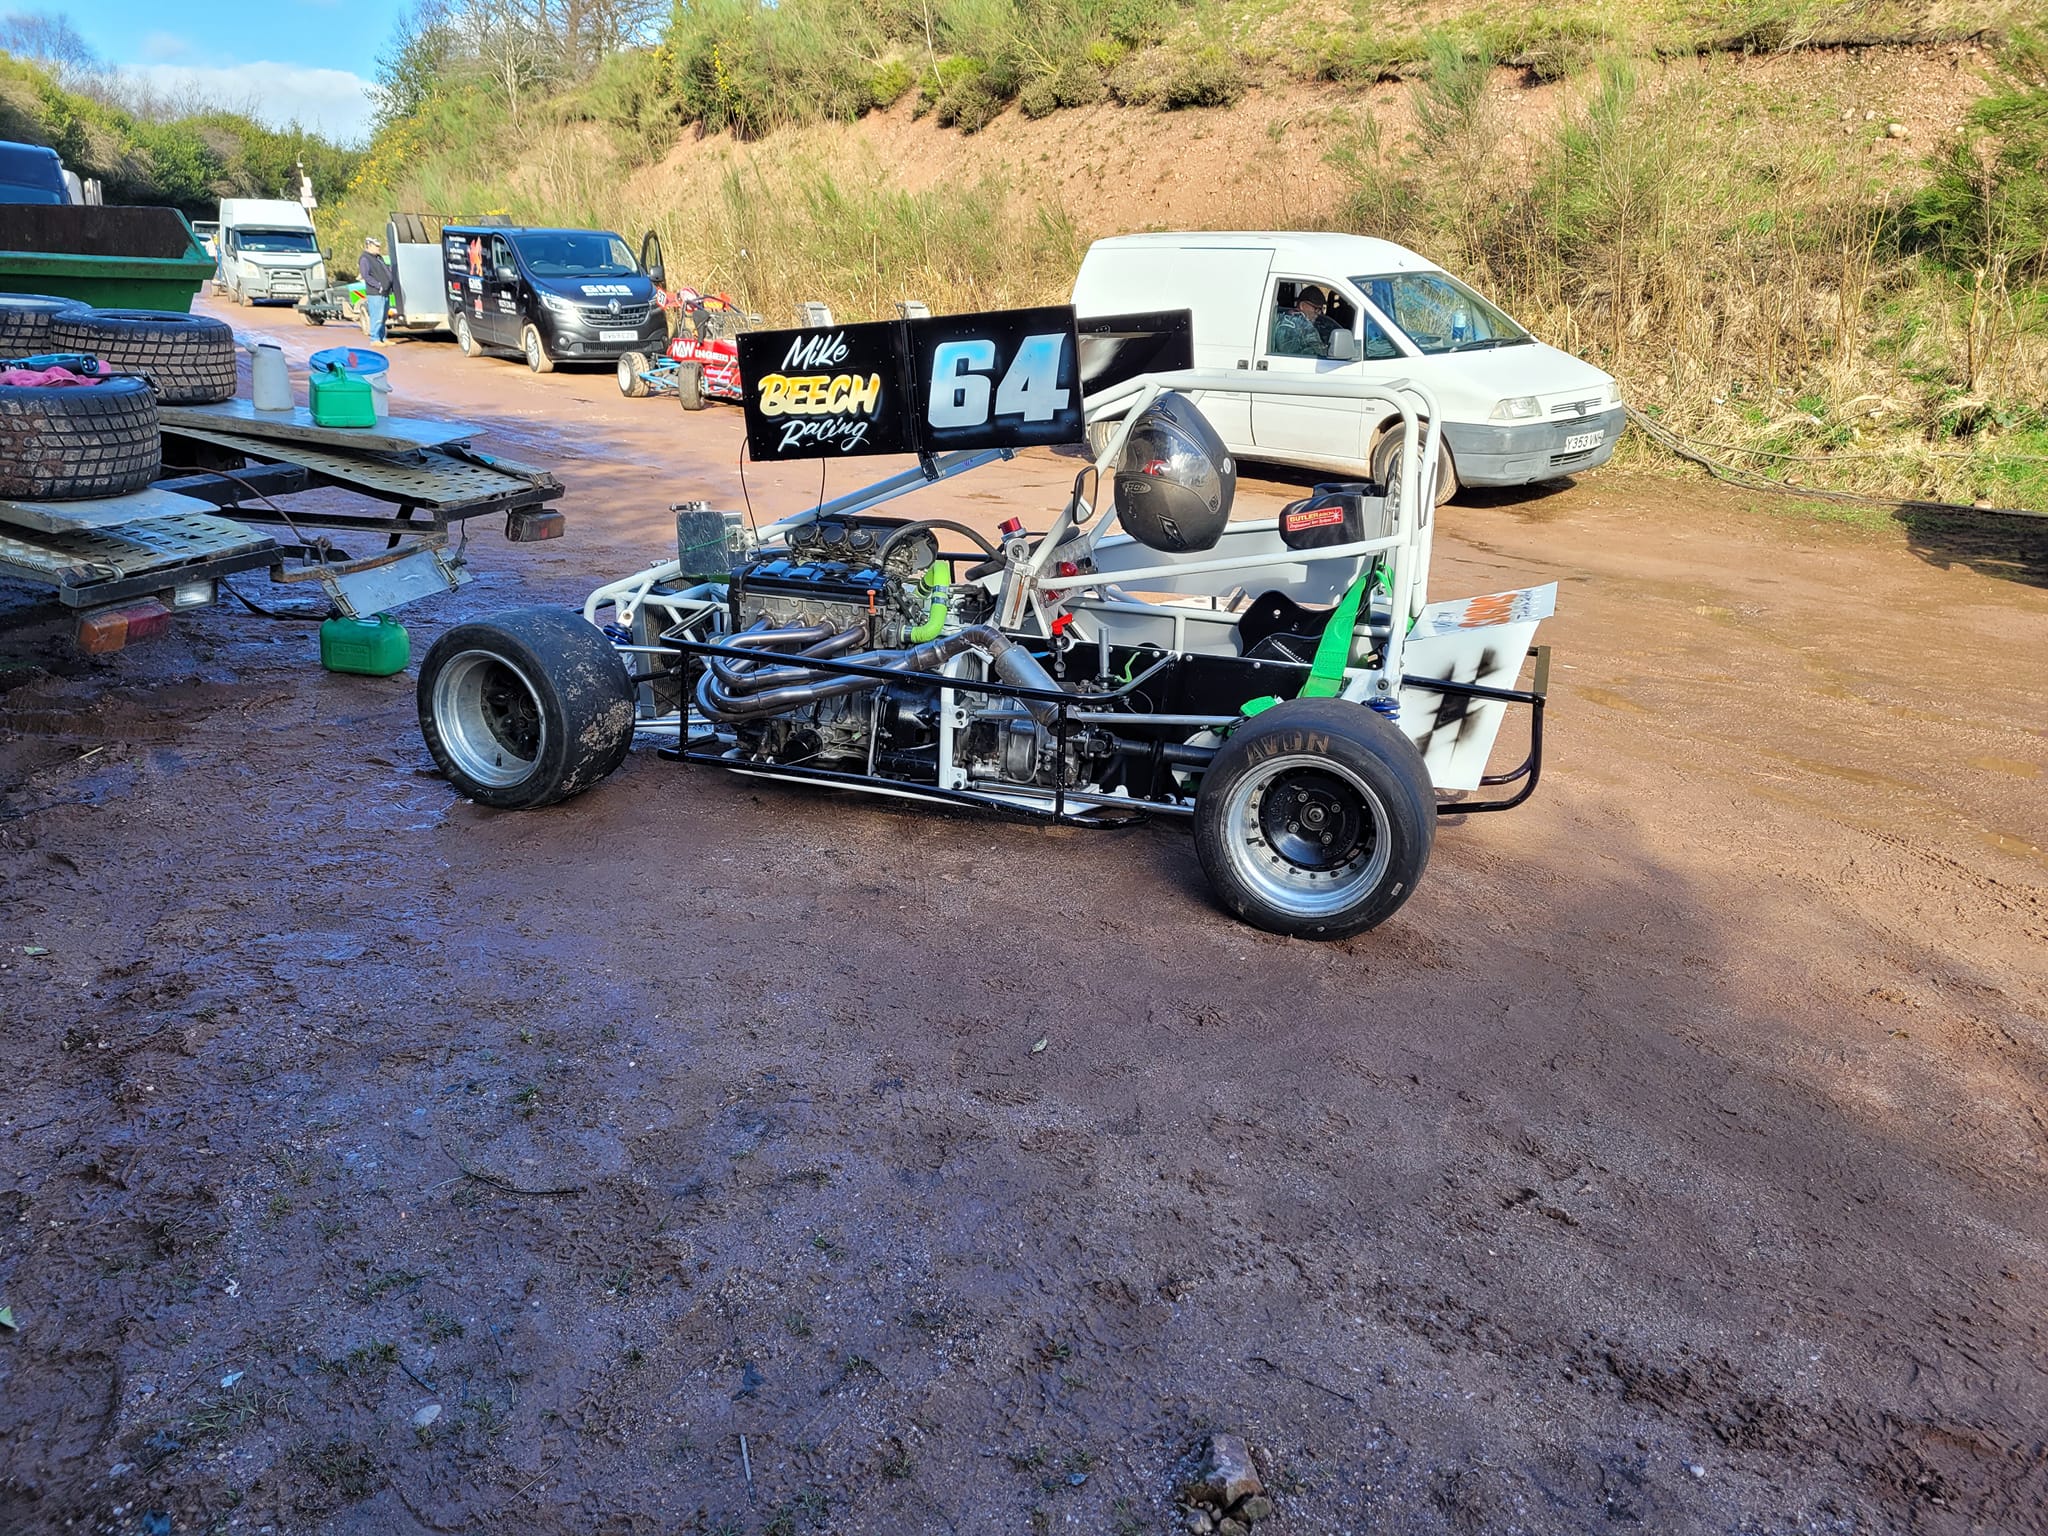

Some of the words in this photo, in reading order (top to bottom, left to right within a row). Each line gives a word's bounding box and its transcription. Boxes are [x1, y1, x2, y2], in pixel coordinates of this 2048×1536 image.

[580, 285, 631, 293] GMS
[781, 331, 849, 370] Mike
[758, 373, 881, 416] BEECH
[928, 332, 1070, 428] 64
[778, 417, 870, 453] Racing
[1567, 435, 1589, 450] Y353
[1246, 731, 1329, 766] AVON
